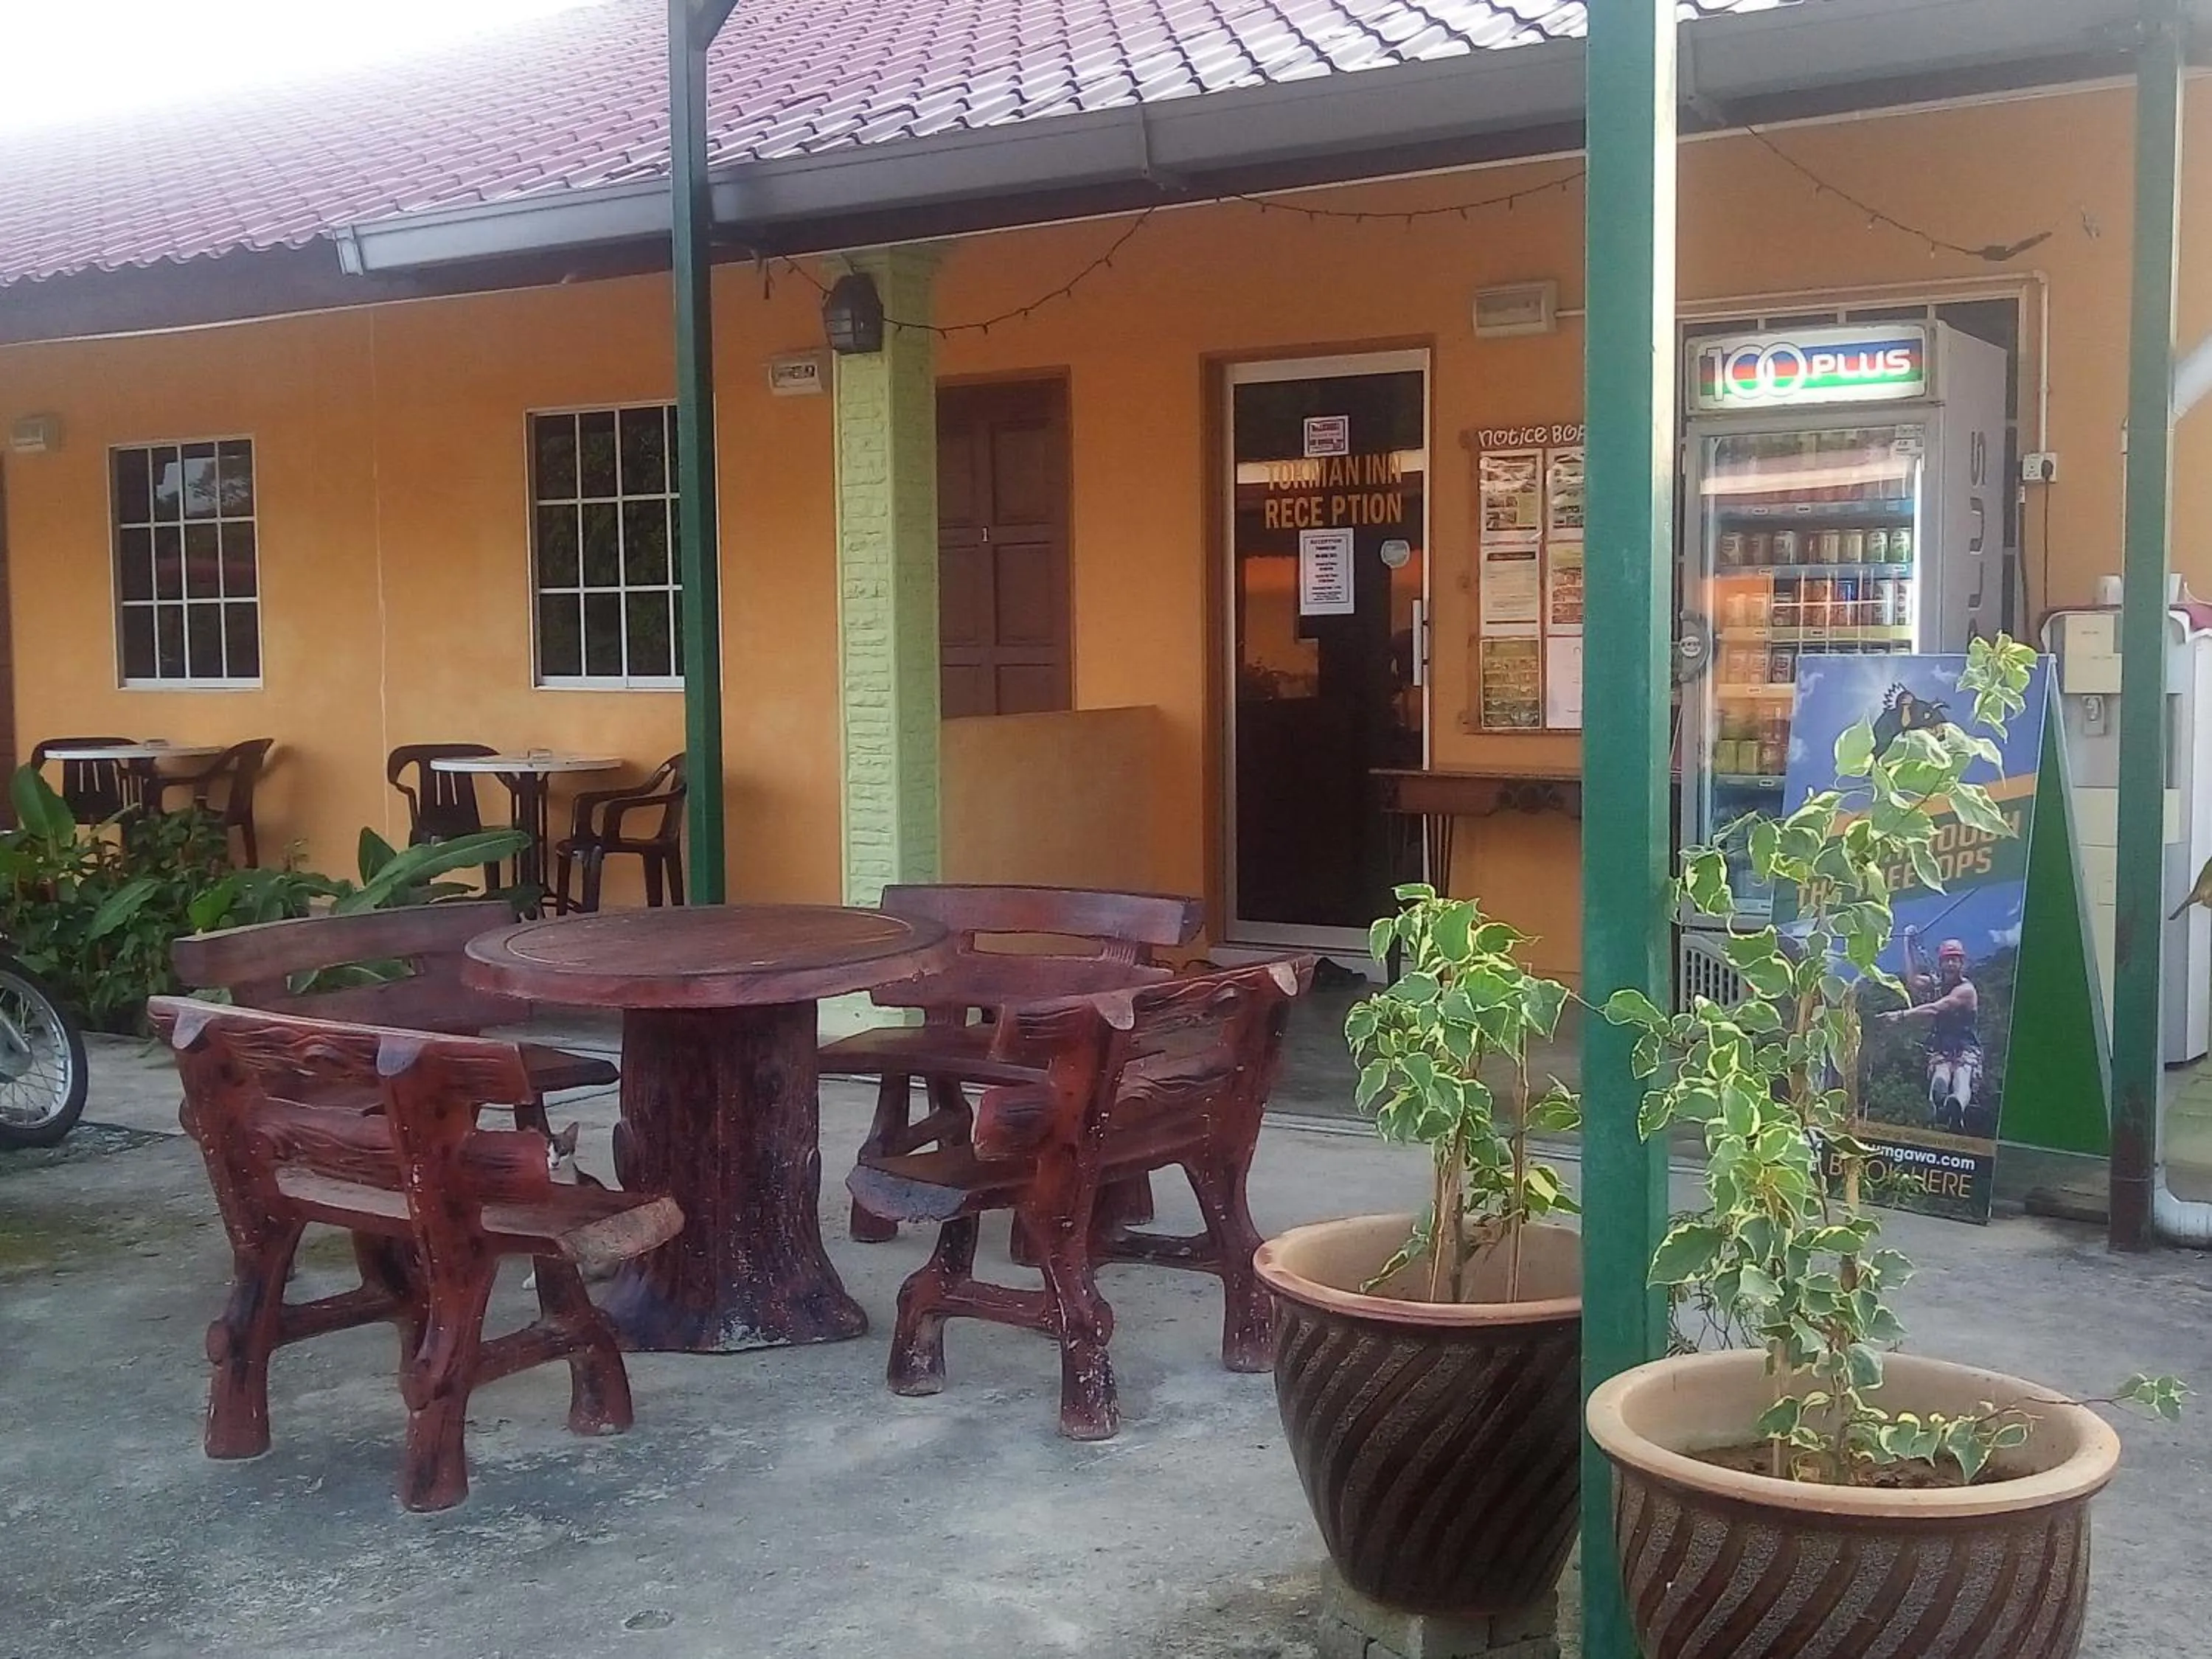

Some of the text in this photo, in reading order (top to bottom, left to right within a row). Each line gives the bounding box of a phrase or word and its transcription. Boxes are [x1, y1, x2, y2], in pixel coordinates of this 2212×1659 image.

[1705, 341, 1912, 402] 100 PLUS
[1551, 424, 1586, 443] BOA
[1366, 453, 1402, 484] INN
[1829, 1152, 1902, 1185] BOK
